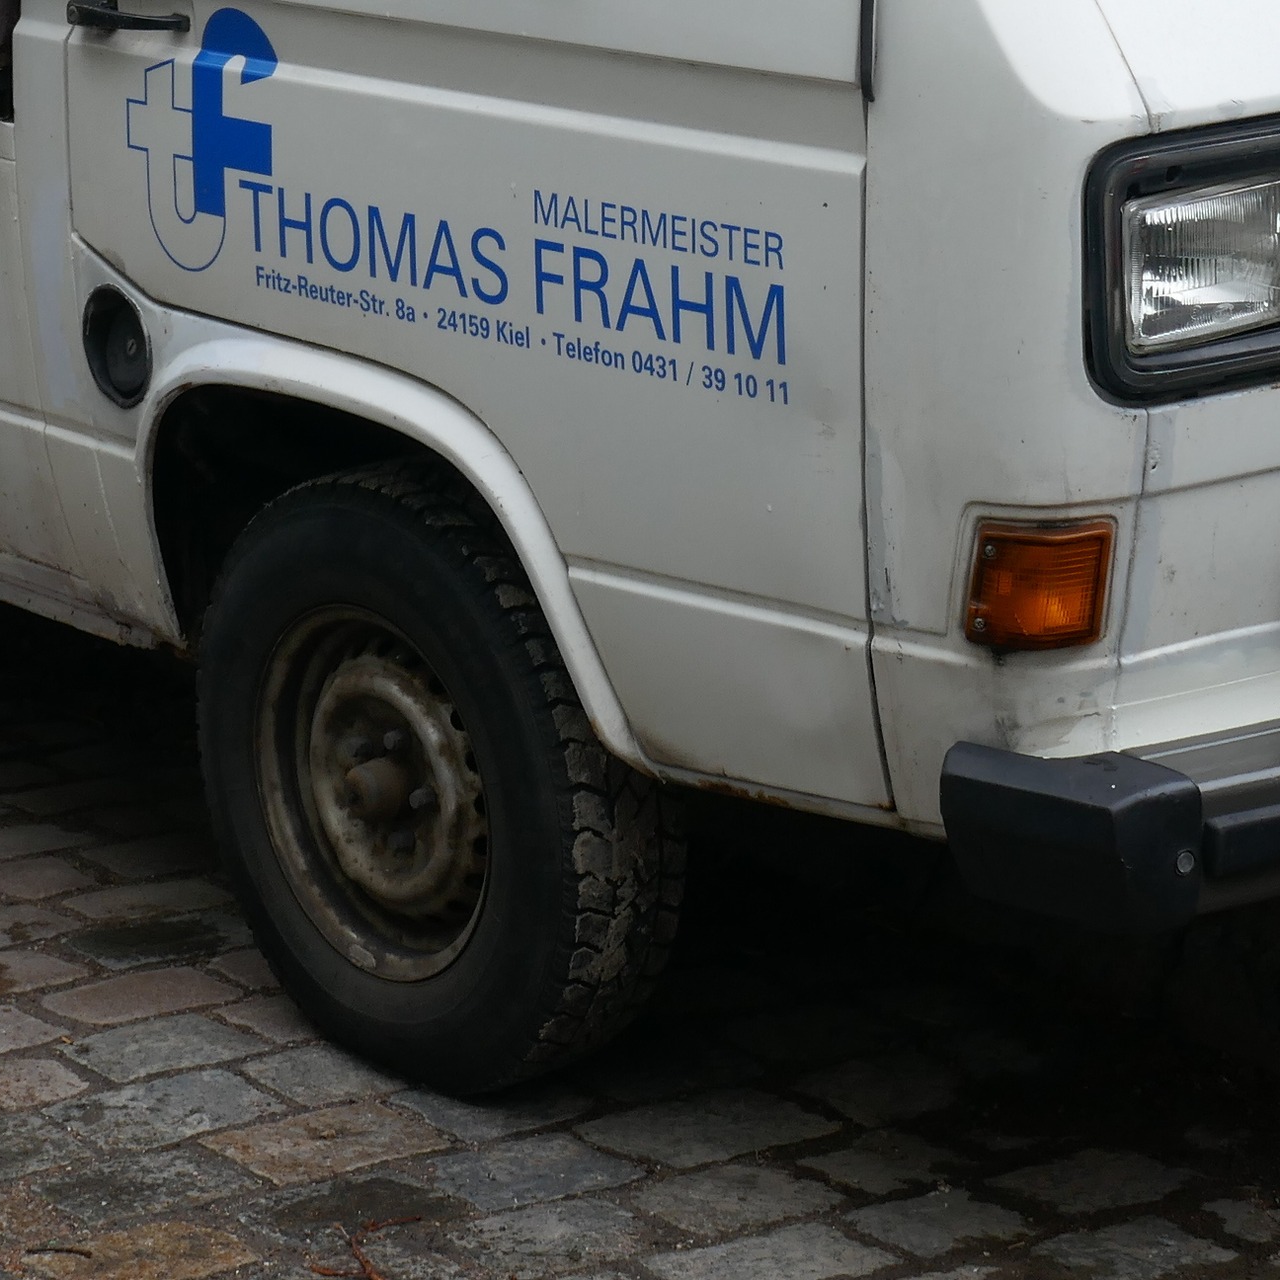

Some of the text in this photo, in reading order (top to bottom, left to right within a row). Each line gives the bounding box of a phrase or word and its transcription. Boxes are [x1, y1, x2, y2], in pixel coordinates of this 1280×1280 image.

[238, 179, 787, 366] THOMAS FRAHM
[533, 189, 784, 270] MALERMEISTER
[255, 265, 390, 317] Fritz-Reuter-Str.
[395, 298, 416, 323] 8a
[437, 307, 490, 339] 24159
[496, 320, 531, 349] Kiel
[552, 332, 626, 370] Telefon
[631, 350, 678, 382] 0431
[702, 365, 726, 392] 39
[734, 372, 758, 399] 10
[765, 379, 789, 405] 11
